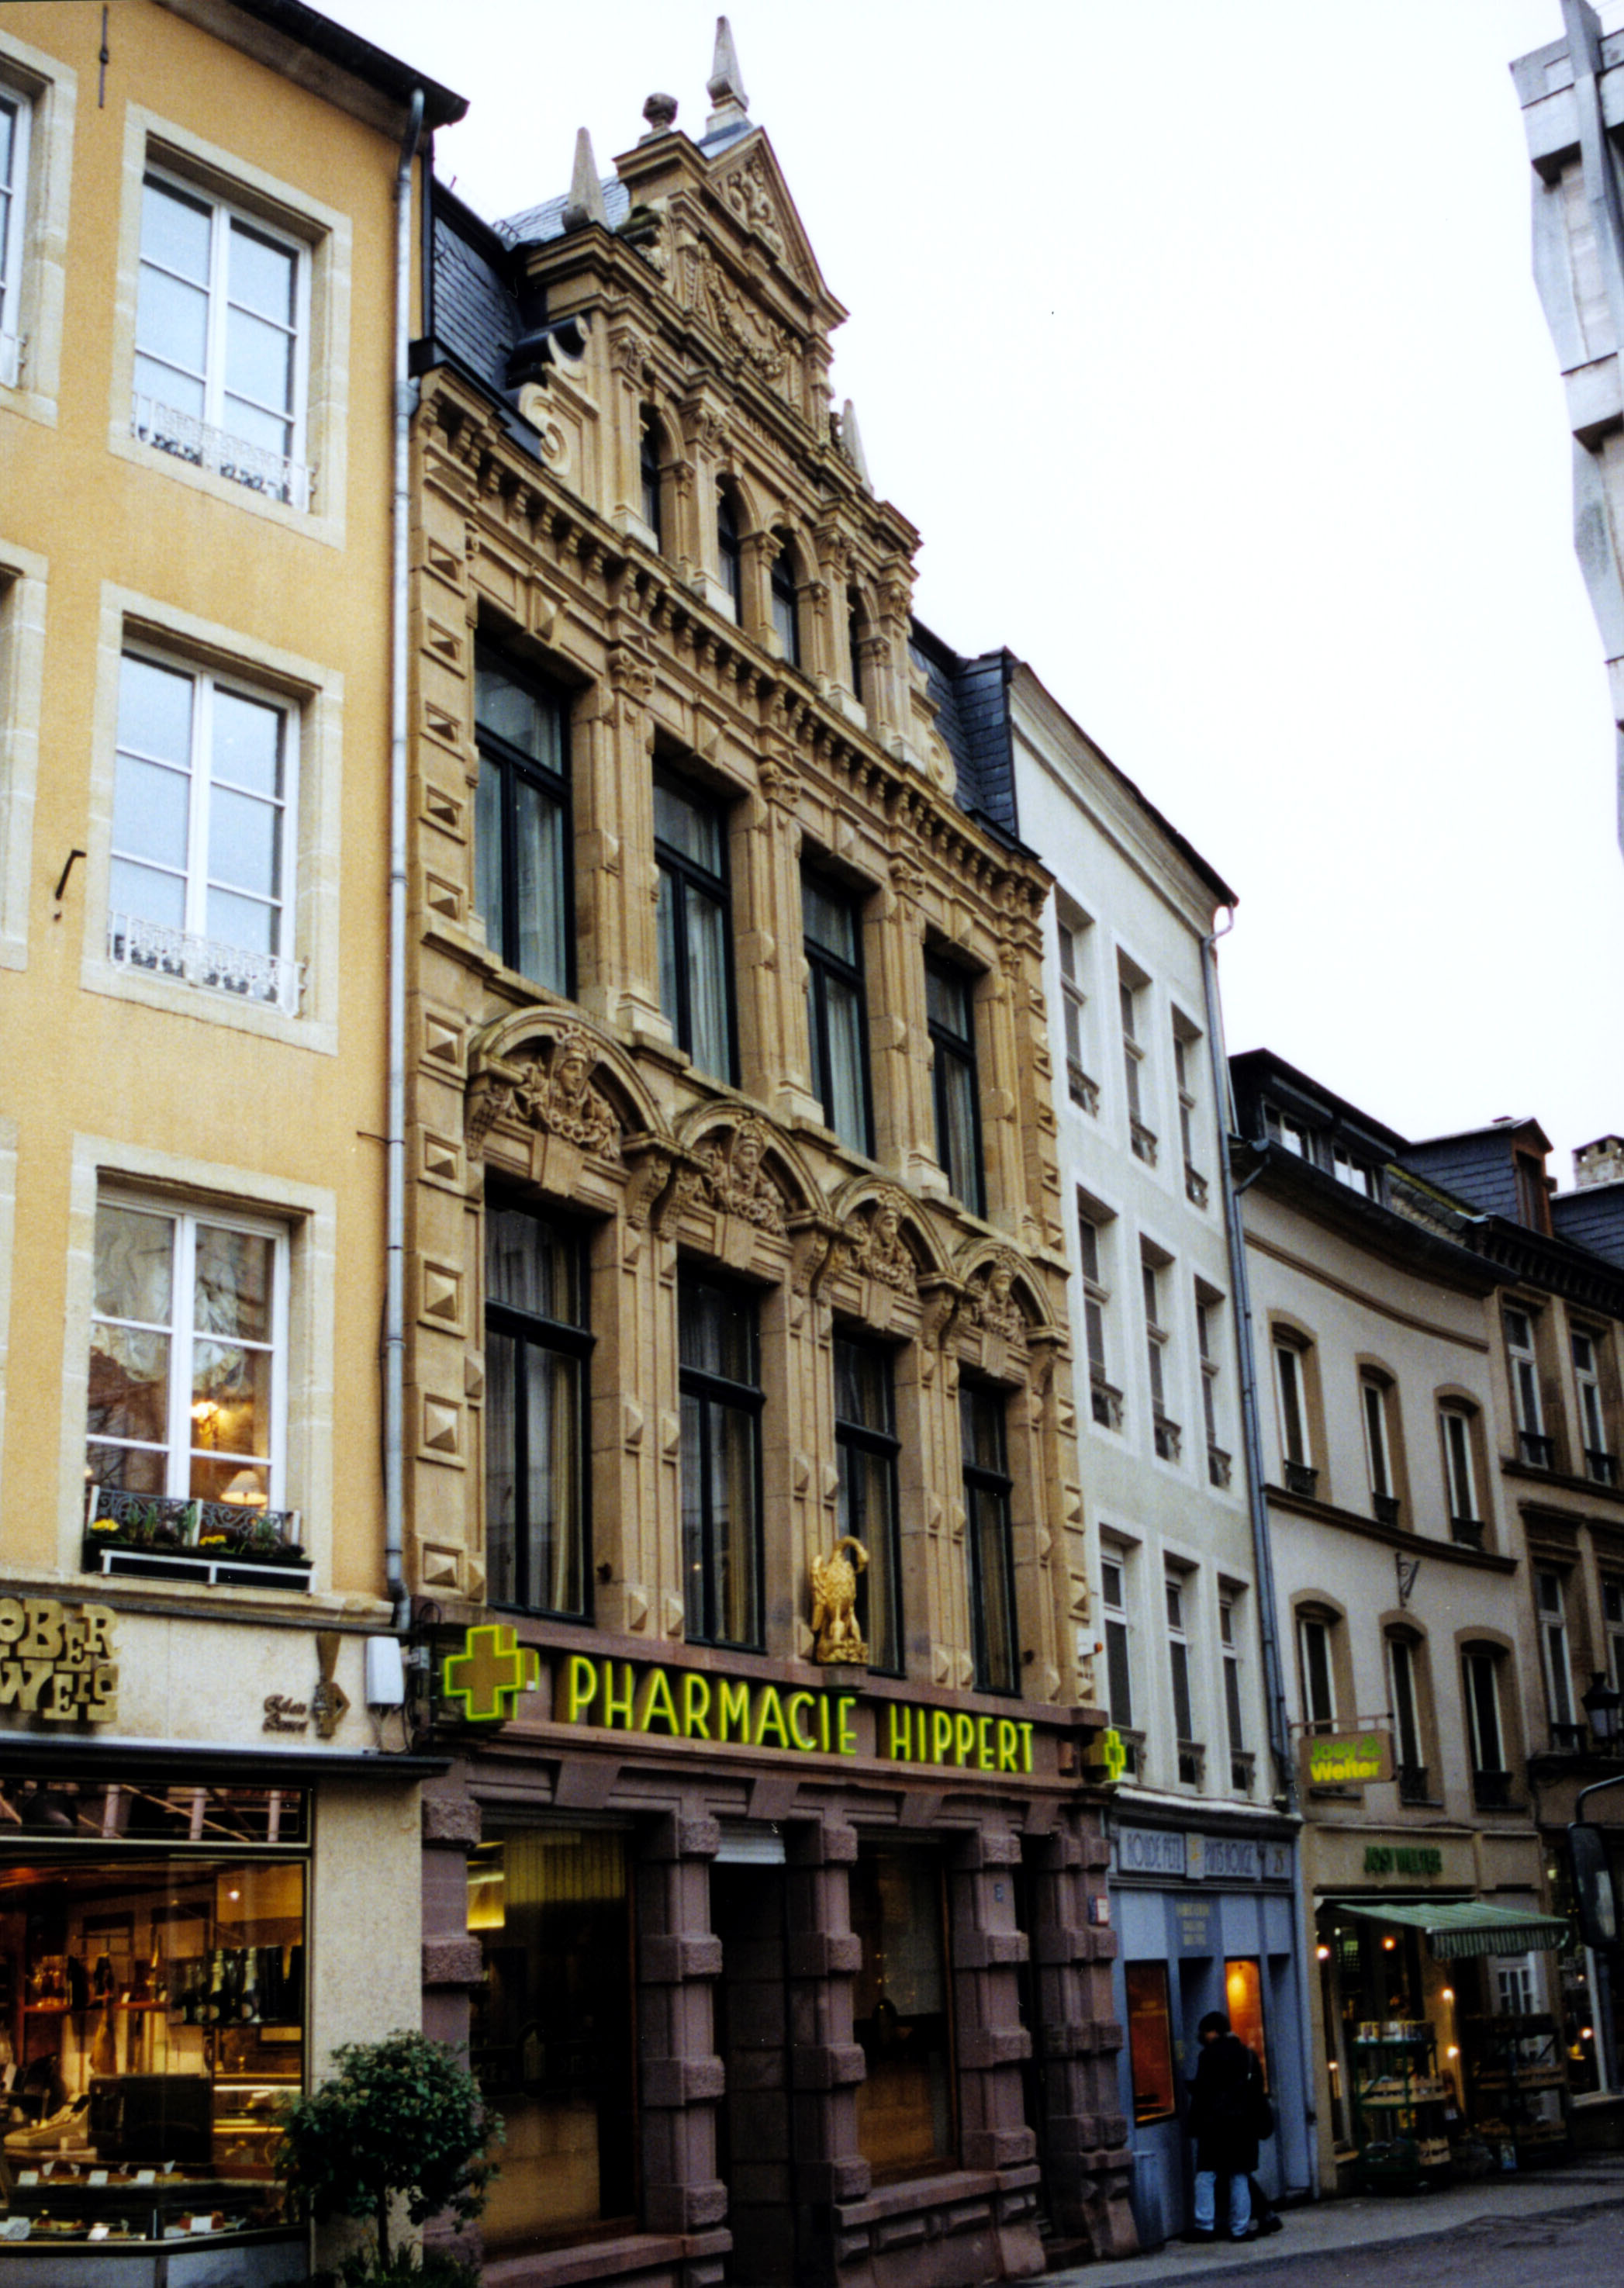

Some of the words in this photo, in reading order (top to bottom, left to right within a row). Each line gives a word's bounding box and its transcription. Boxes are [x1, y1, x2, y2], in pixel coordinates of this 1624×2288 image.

[568, 1654, 857, 1756] PHARMACIE
[890, 1703, 1035, 1774] HIPPERT
[1309, 1757, 1380, 1782] Welter
